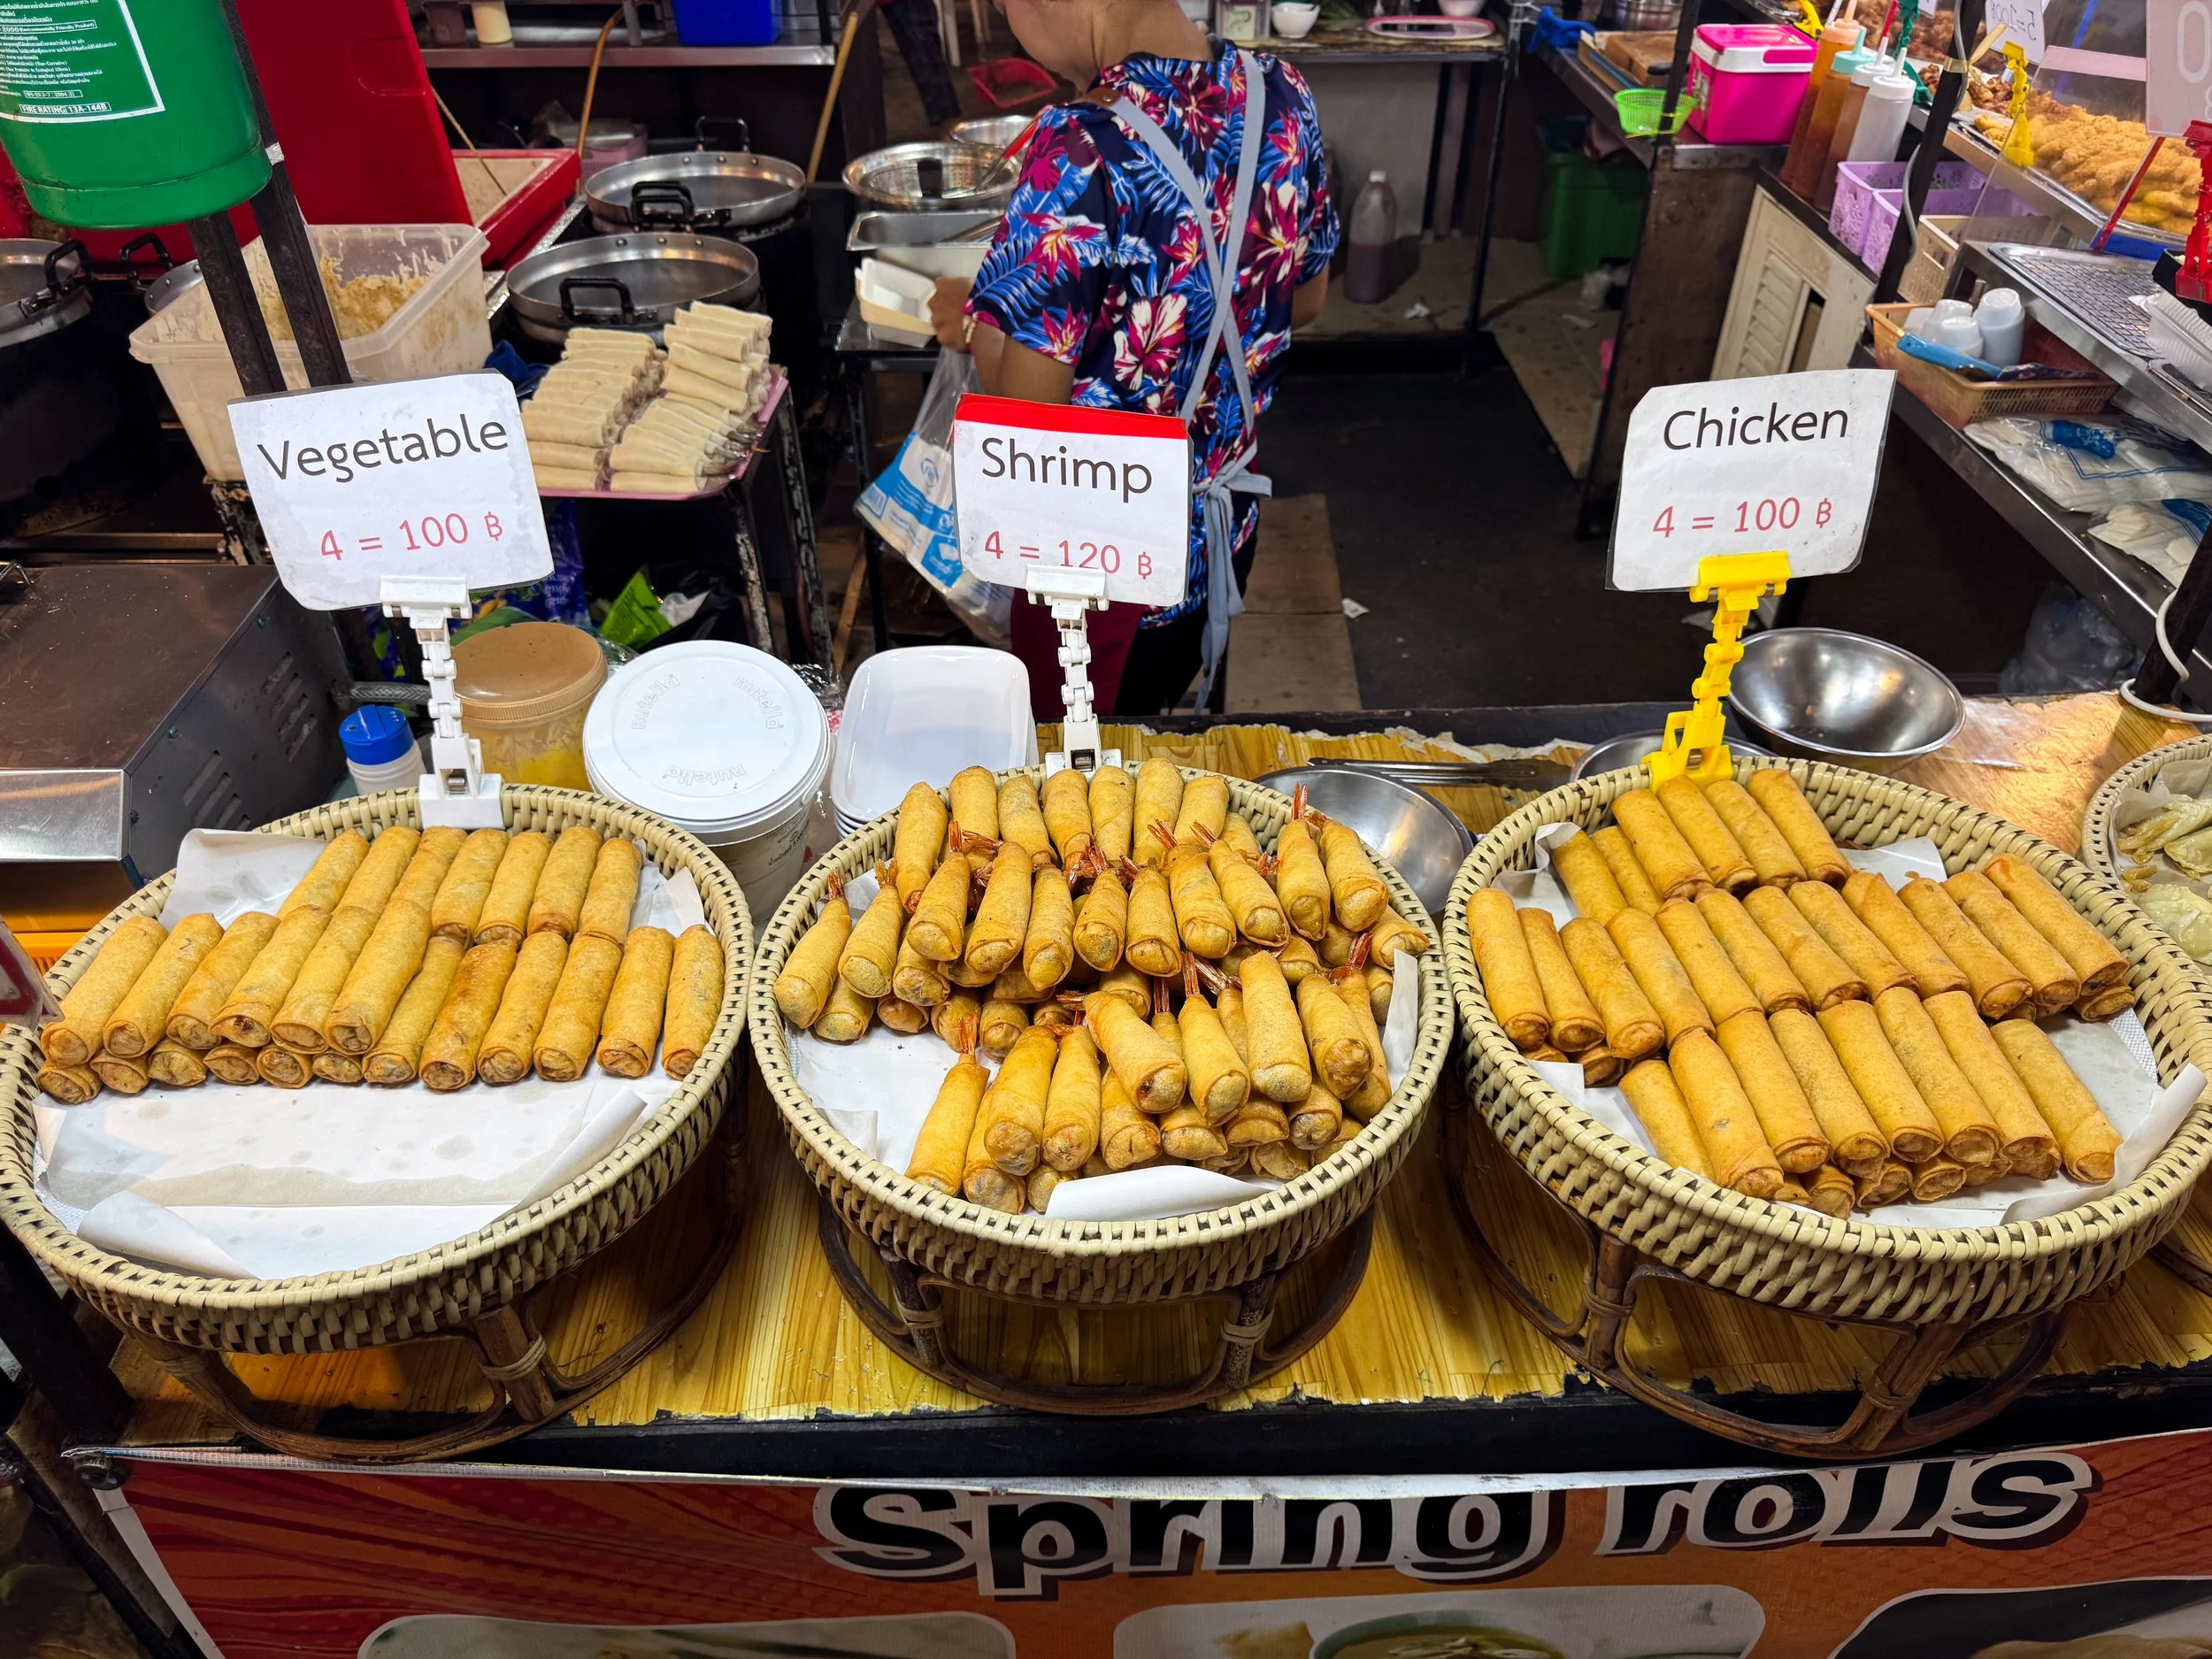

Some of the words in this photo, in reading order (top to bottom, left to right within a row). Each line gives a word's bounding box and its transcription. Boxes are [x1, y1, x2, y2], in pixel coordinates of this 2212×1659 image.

[38, 105, 66, 114] RATING
[67, 104, 108, 113] 13A-144B
[257, 413, 509, 483] Vegetable
[1663, 402, 1849, 450] Chicken
[981, 437, 1152, 503] Shrimp
[320, 529, 343, 561] 4
[358, 536, 382, 551] =
[399, 512, 469, 551] 100
[1652, 505, 1675, 538] 4
[1691, 516, 1715, 530] =
[1734, 496, 1801, 534] 100
[984, 531, 1004, 559] 4
[1019, 545, 1040, 559] =
[1058, 540, 1121, 574] 120
[632, 673, 681, 730] nutella
[733, 677, 784, 730] nutella
[663, 764, 747, 787] nutella
[813, 1488, 1552, 1596] Spring
[1594, 1453, 2092, 1555] rolls
